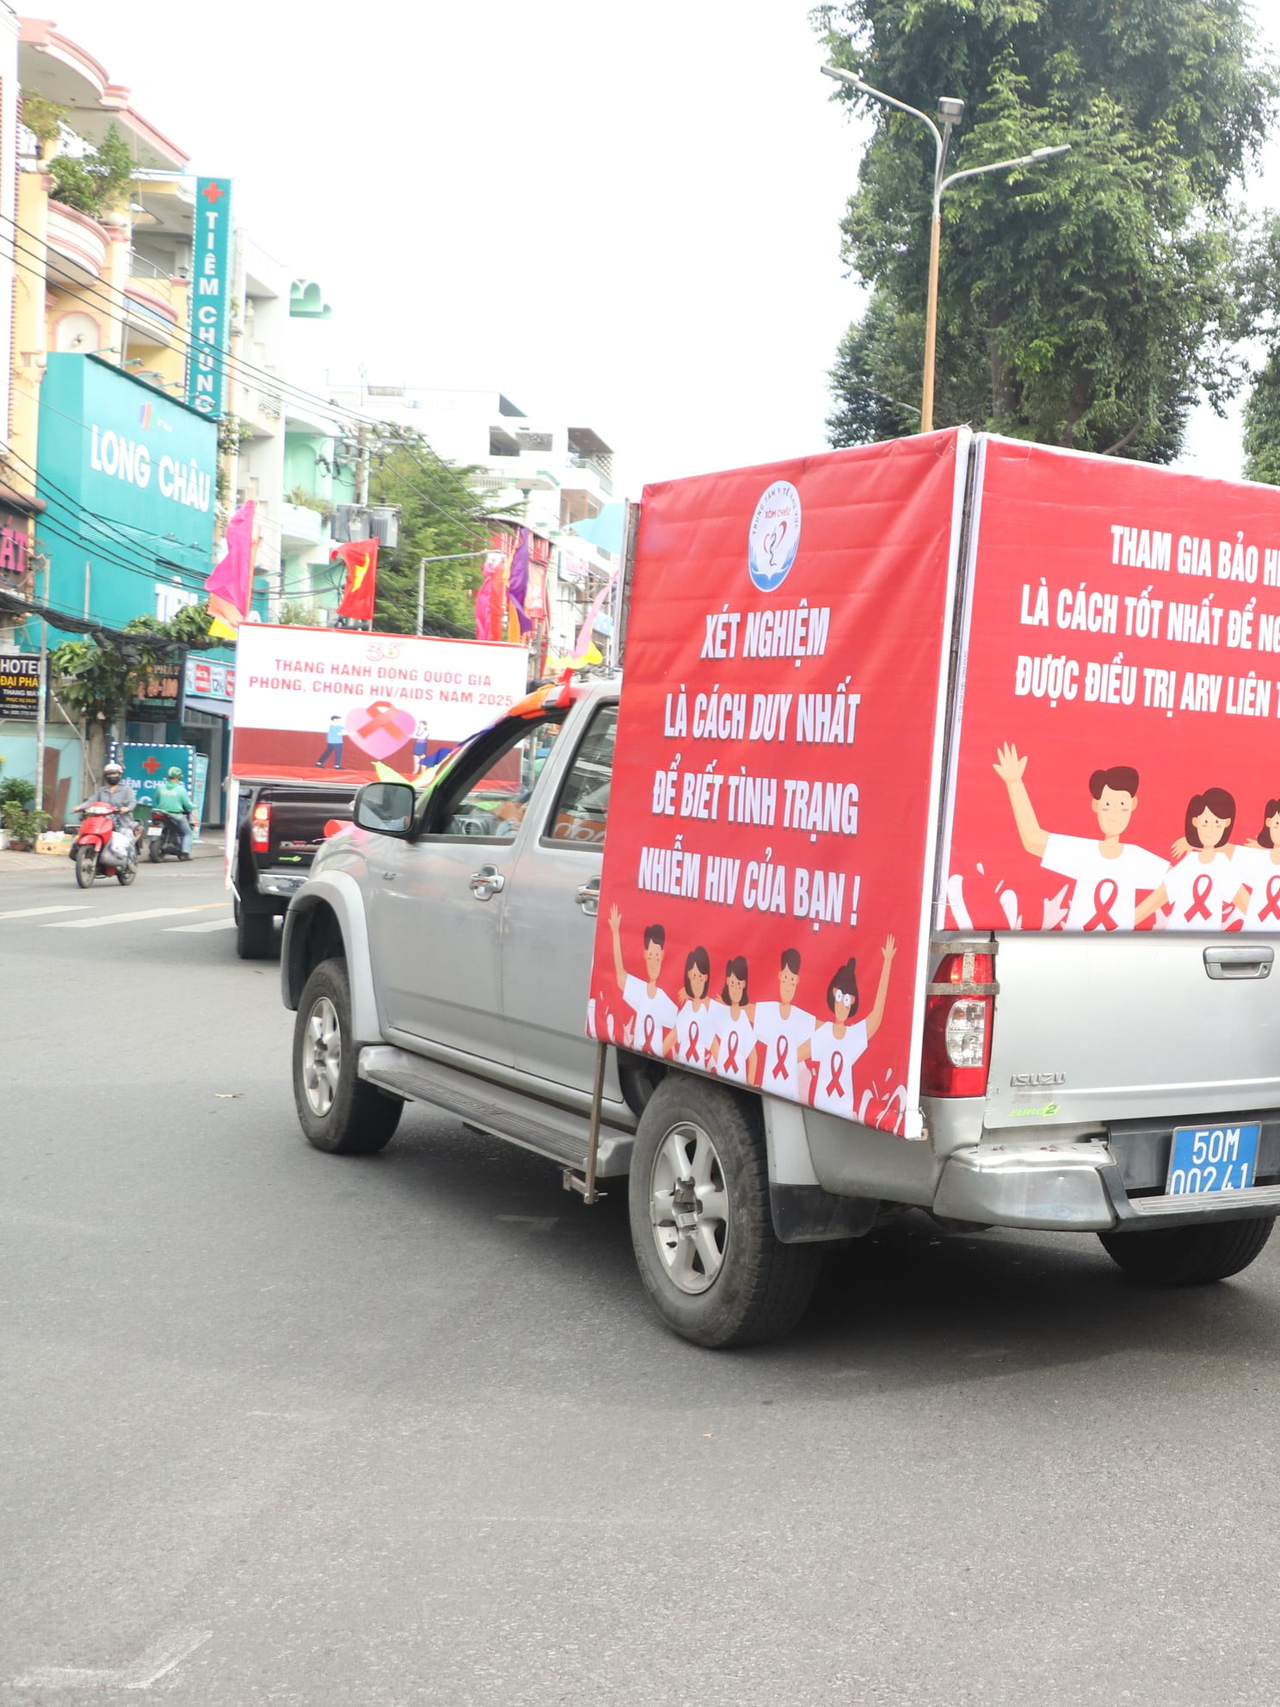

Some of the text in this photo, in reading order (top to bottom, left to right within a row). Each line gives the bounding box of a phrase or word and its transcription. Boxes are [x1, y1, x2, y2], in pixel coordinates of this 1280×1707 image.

[199, 211, 219, 296] TIÊM
[90, 423, 211, 513] LONG CHÂU
[1111, 524, 1172, 572] THAM
[1177, 534, 1211, 578] GIA
[1217, 530, 1259, 585] BẢO
[700, 598, 831, 667] XÉT NGHIỆM
[1020, 577, 1050, 627] LÀ
[1056, 581, 1119, 635] CÁCH
[1124, 585, 1163, 639] TỐT
[1167, 593, 1224, 647] NHẤT
[1227, 597, 1257, 650] ĐỂ
[0, 674, 39, 689] ĐẠI PHÁ
[370, 684, 434, 701] HIV/AIDS
[478, 693, 514, 707] 2025
[468, 674, 492, 687] GIA
[664, 675, 861, 744] LÀ CÁCH DUY NHẤT
[1015, 653, 1079, 708] ĐƯỢC
[1085, 652, 1138, 706] ĐIỀU
[1143, 667, 1177, 718] TRỊ
[1180, 672, 1221, 714] ARV
[1226, 671, 1270, 717] LIÊN
[652, 752, 860, 843] ĐỂ BIẾT TÌNH TRẠNG
[638, 834, 861, 932] NHIỄM HIV CỦA BẠN !
[1009, 1071, 1067, 1087] ISUZU
[1170, 1162, 1249, 1196] 00241
[1192, 1128, 1241, 1165] 50M
